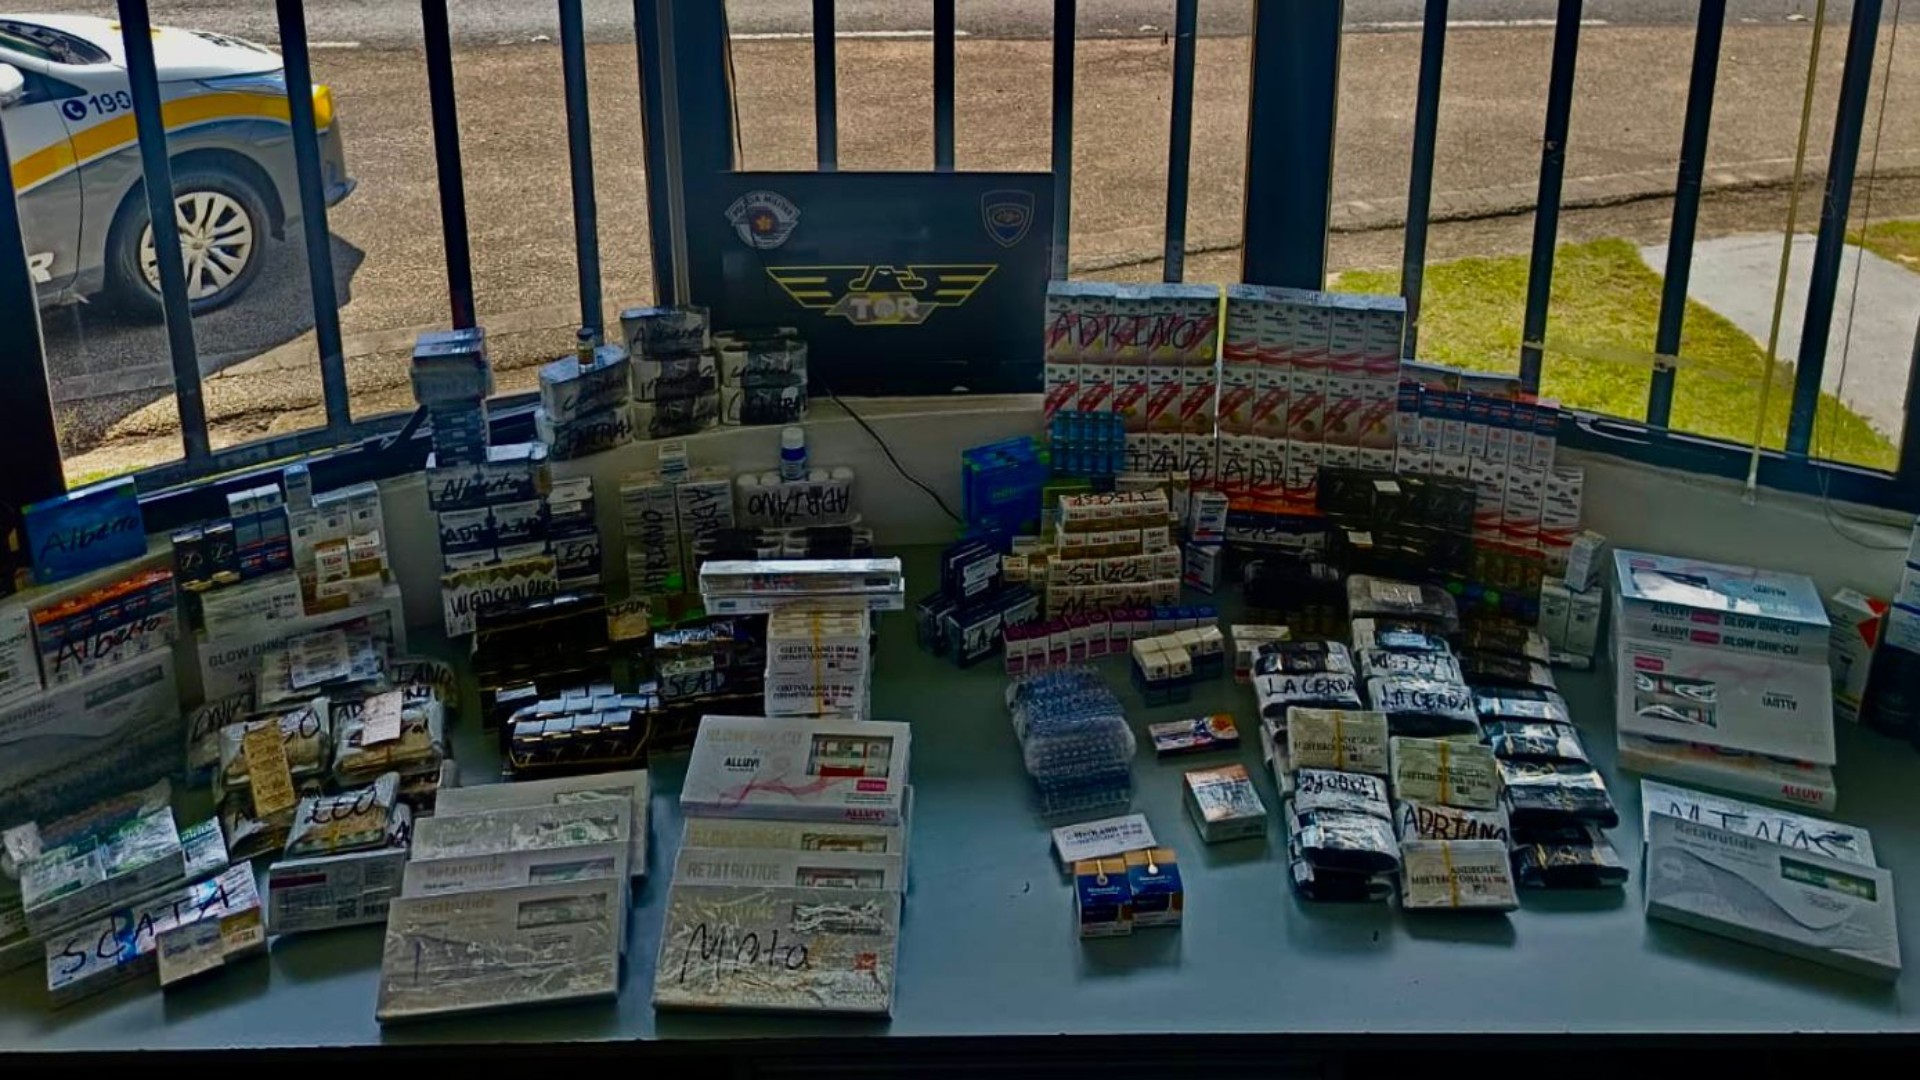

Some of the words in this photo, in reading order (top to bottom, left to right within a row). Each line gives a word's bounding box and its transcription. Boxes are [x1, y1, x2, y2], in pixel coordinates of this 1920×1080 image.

[89, 91, 132, 114] 190
[850, 298, 919, 321] TOR
[724, 757, 760, 768] ALLUVI
[1402, 804, 1509, 842] ADRIANO
